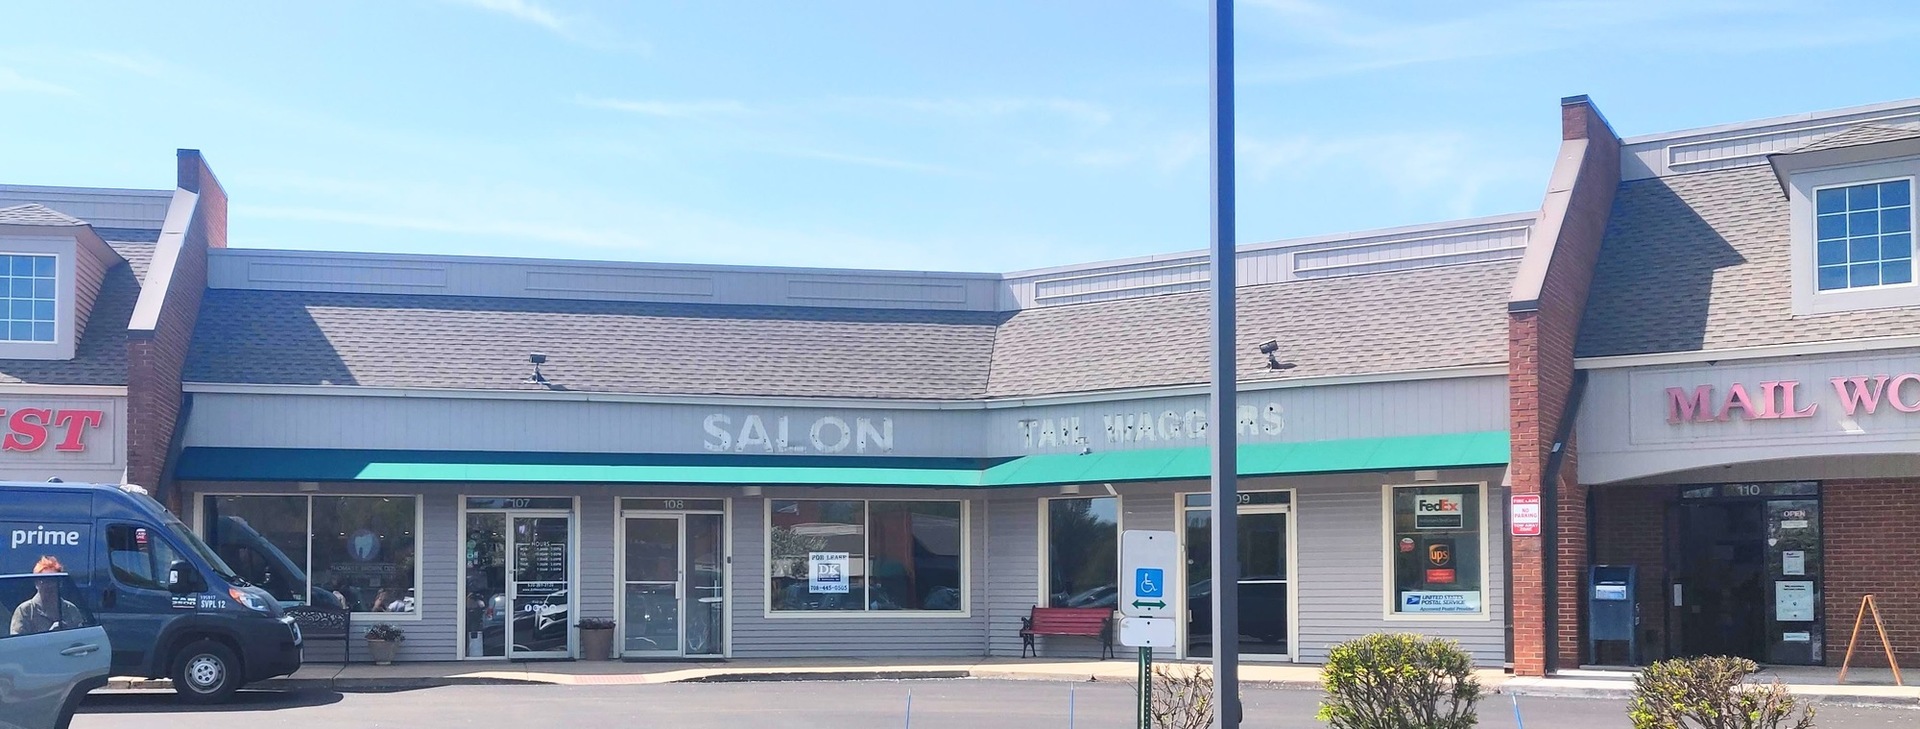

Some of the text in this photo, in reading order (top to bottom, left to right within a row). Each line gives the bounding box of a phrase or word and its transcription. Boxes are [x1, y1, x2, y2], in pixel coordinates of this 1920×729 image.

[1666, 379, 1819, 424] MAIL
[0, 407, 103, 452] ST
[1018, 402, 1285, 447] TAIL WAGGRS
[703, 413, 894, 453] SALON
[1737, 484, 1760, 496] 110
[511, 499, 530, 508] 107
[663, 500, 684, 509] 108
[1419, 499, 1458, 512] FedEx
[11, 525, 80, 549] prime
[1431, 550, 1448, 563] ups
[818, 564, 840, 575] DK
[200, 600, 216, 608] SVPL
